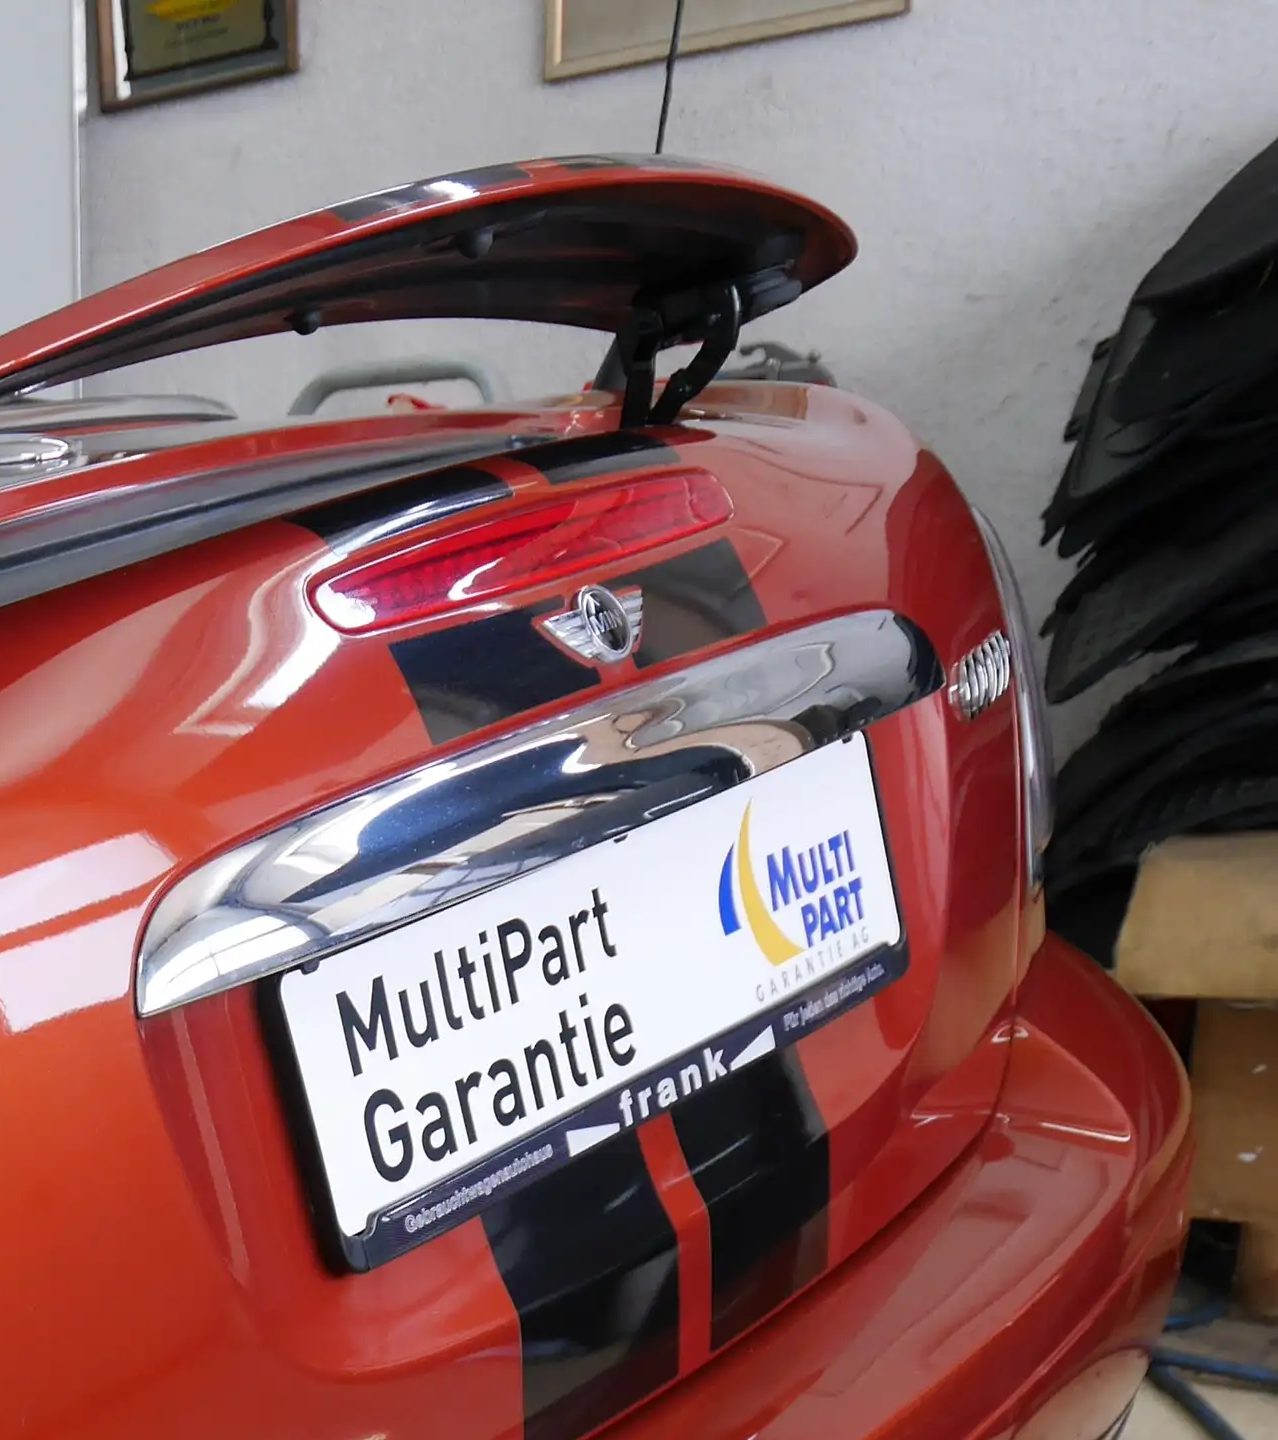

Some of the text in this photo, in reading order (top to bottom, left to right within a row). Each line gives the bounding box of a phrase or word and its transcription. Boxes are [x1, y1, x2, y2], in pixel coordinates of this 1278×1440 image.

[766, 829, 856, 912] MULTI
[800, 876, 865, 949] PART
[335, 887, 618, 1077] MultiPart
[755, 926, 870, 1002] GARANTIE AG
[363, 993, 637, 1183] Garantie
[619, 1047, 728, 1128] frank
